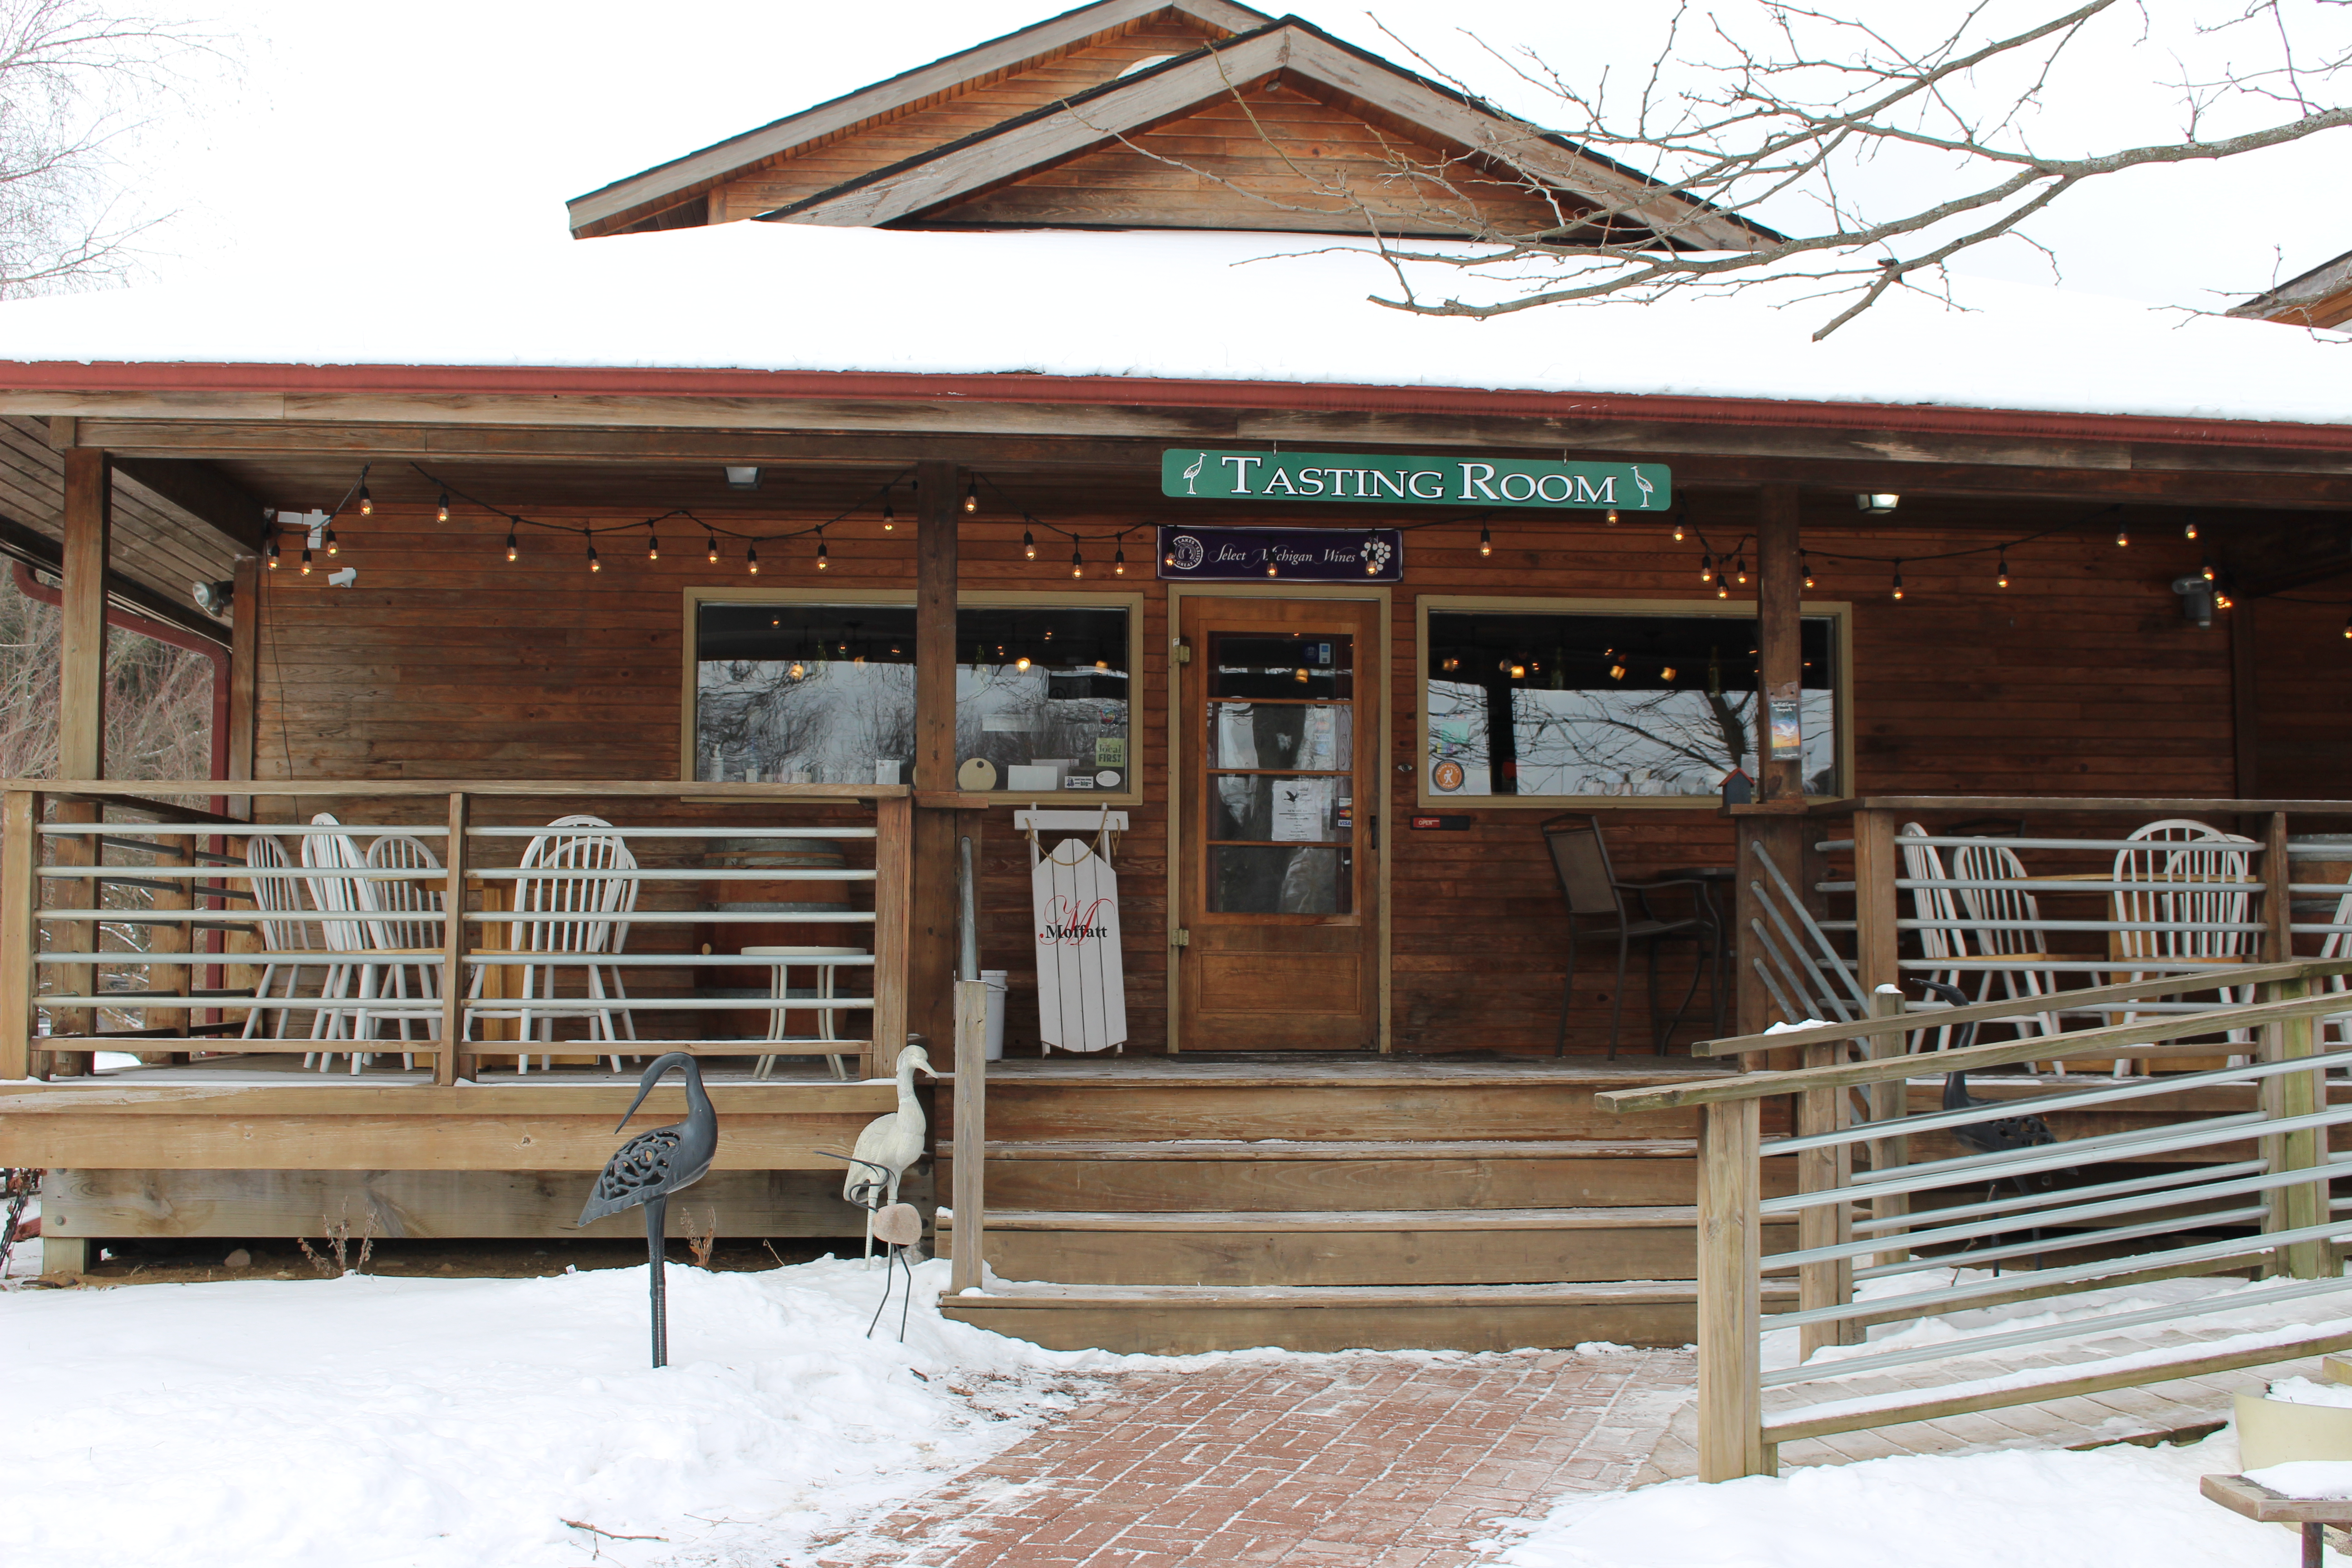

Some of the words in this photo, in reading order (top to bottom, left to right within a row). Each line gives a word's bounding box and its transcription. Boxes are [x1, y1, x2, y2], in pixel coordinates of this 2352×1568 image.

[1221, 456, 1445, 499] TASTING
[1457, 462, 1618, 503] ROOM
[1208, 543, 1247, 563] Select
[1241, 544, 1313, 568] Mchigan
[1315, 547, 1357, 564] Wines
[1099, 744, 1122, 753] local
[1098, 754, 1122, 762] FIRST
[1045, 925, 1107, 939] Moffatt
